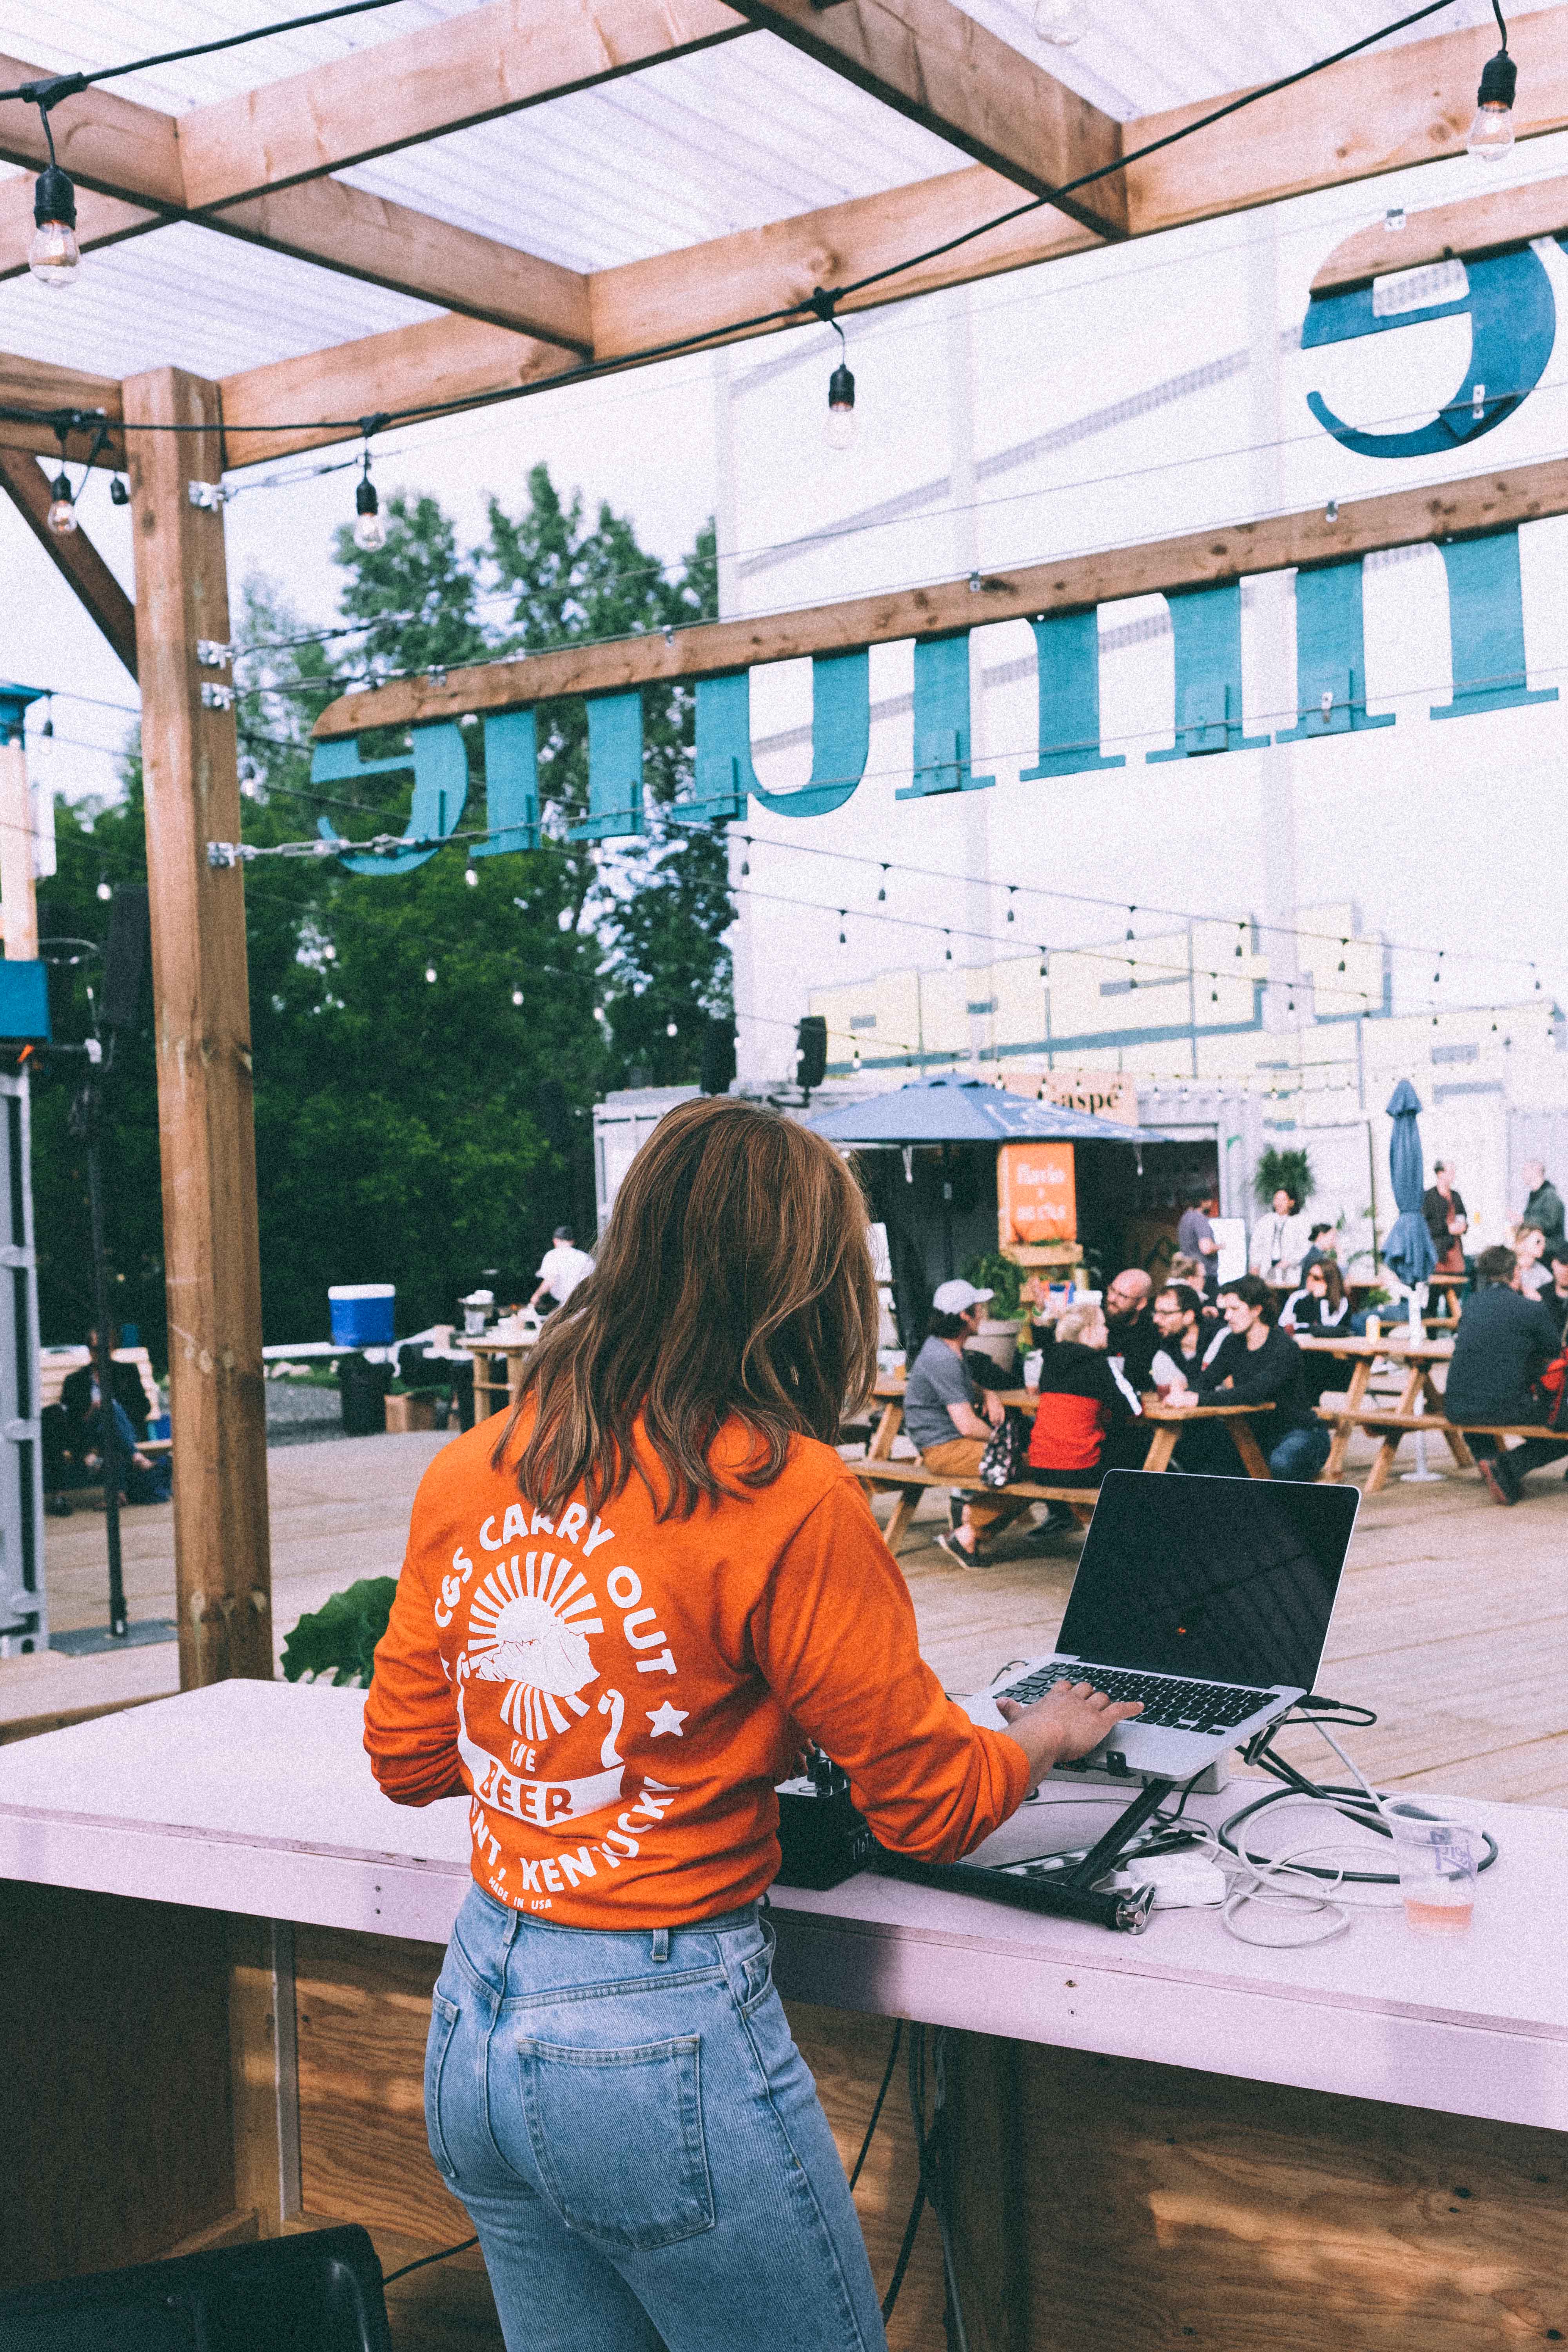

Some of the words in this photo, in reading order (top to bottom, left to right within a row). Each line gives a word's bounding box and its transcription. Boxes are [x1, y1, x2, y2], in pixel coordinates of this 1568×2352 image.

[479, 1502, 615, 1557] CARRY
[607, 1566, 677, 1675] OUT
[510, 1739, 536, 1772] THE
[479, 1759, 573, 1821] BEER
[472, 1795, 506, 1882] NT,
[519, 1776, 681, 1893] KENTUCKY
[488, 1876, 509, 1901] MADE
[513, 1896, 524, 1908] IN
[531, 1898, 552, 1910] USA
